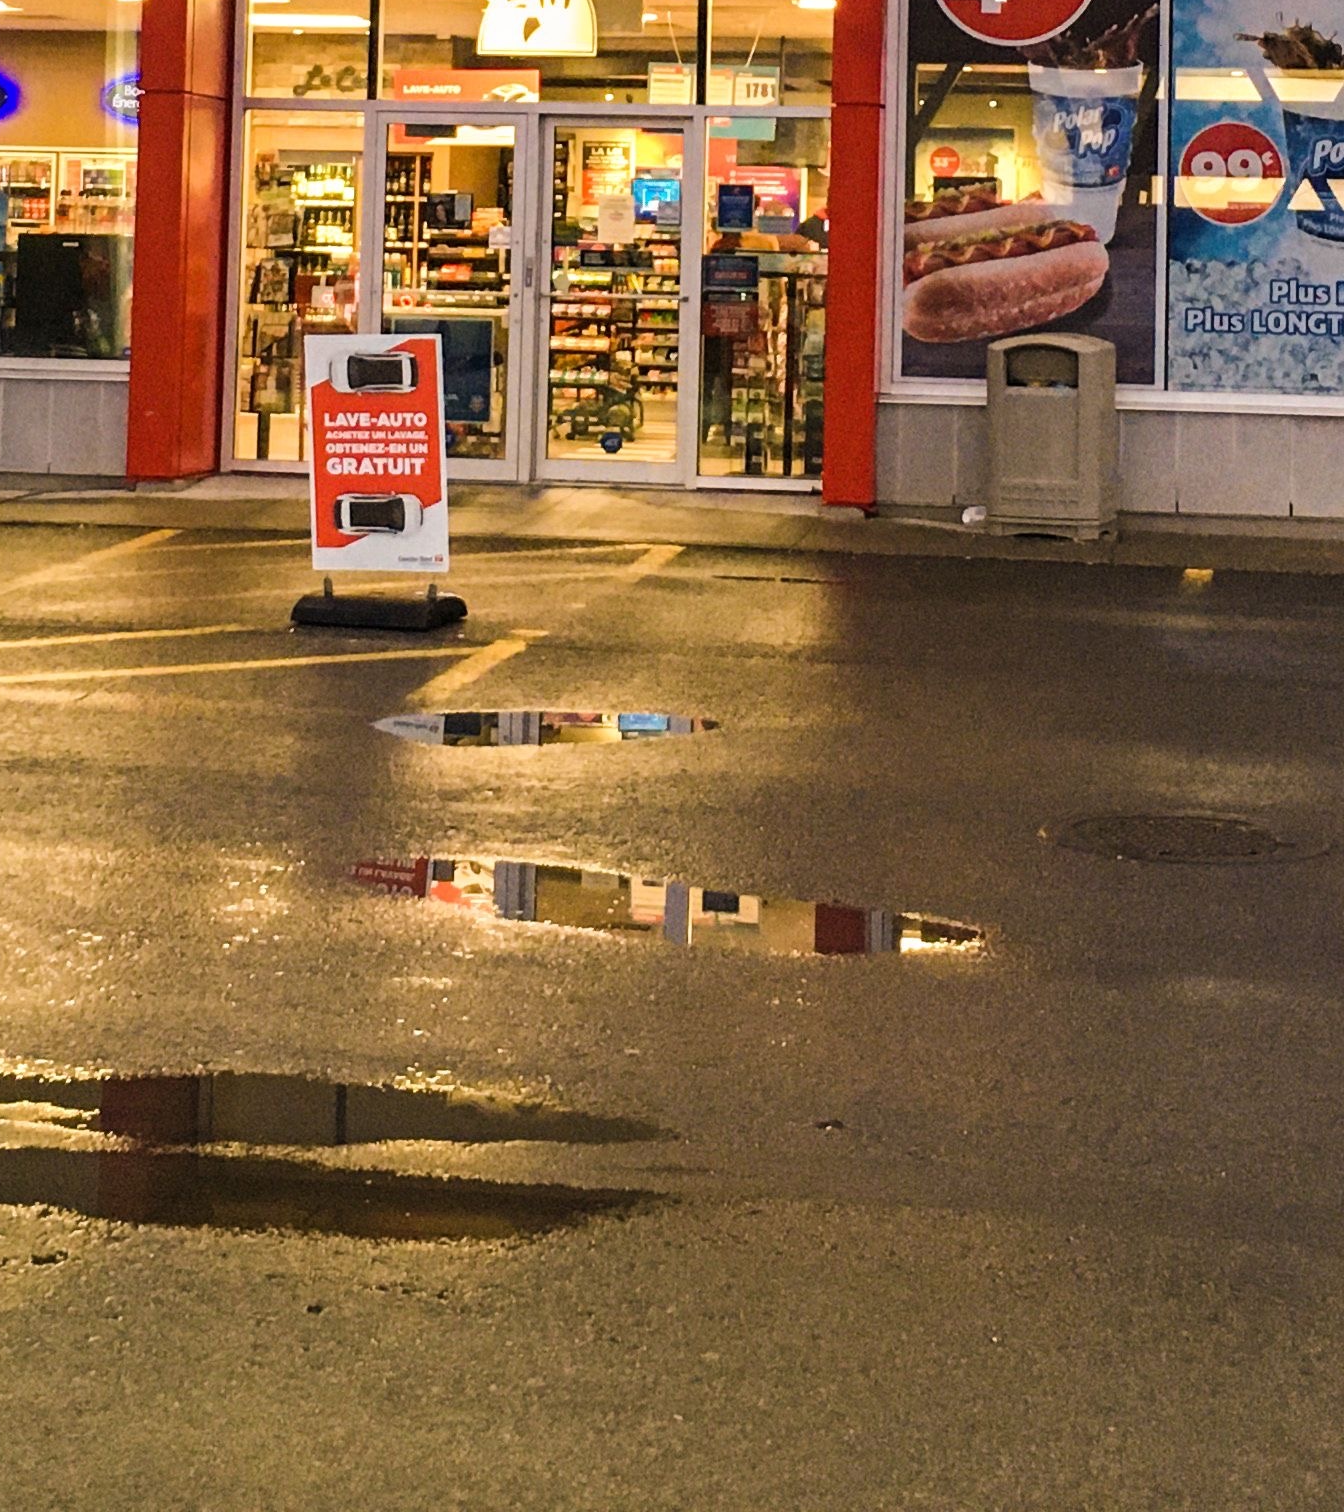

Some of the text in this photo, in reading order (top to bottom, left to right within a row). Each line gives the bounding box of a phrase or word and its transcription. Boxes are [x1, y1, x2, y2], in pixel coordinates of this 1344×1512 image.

[402, 85, 462, 95] LAVE-AUTO
[745, 82, 776, 99] 1781
[1052, 105, 1104, 134] Polar
[1078, 129, 1117, 156] Pop
[1270, 278, 1330, 305] Plus
[1185, 307, 1245, 333] Plus
[323, 412, 428, 428] LAVE-AUTO
[371, 431, 386, 440] UN
[325, 443, 429, 454] OBTENEZ-EN UN
[325, 457, 426, 476] GRATUIT
